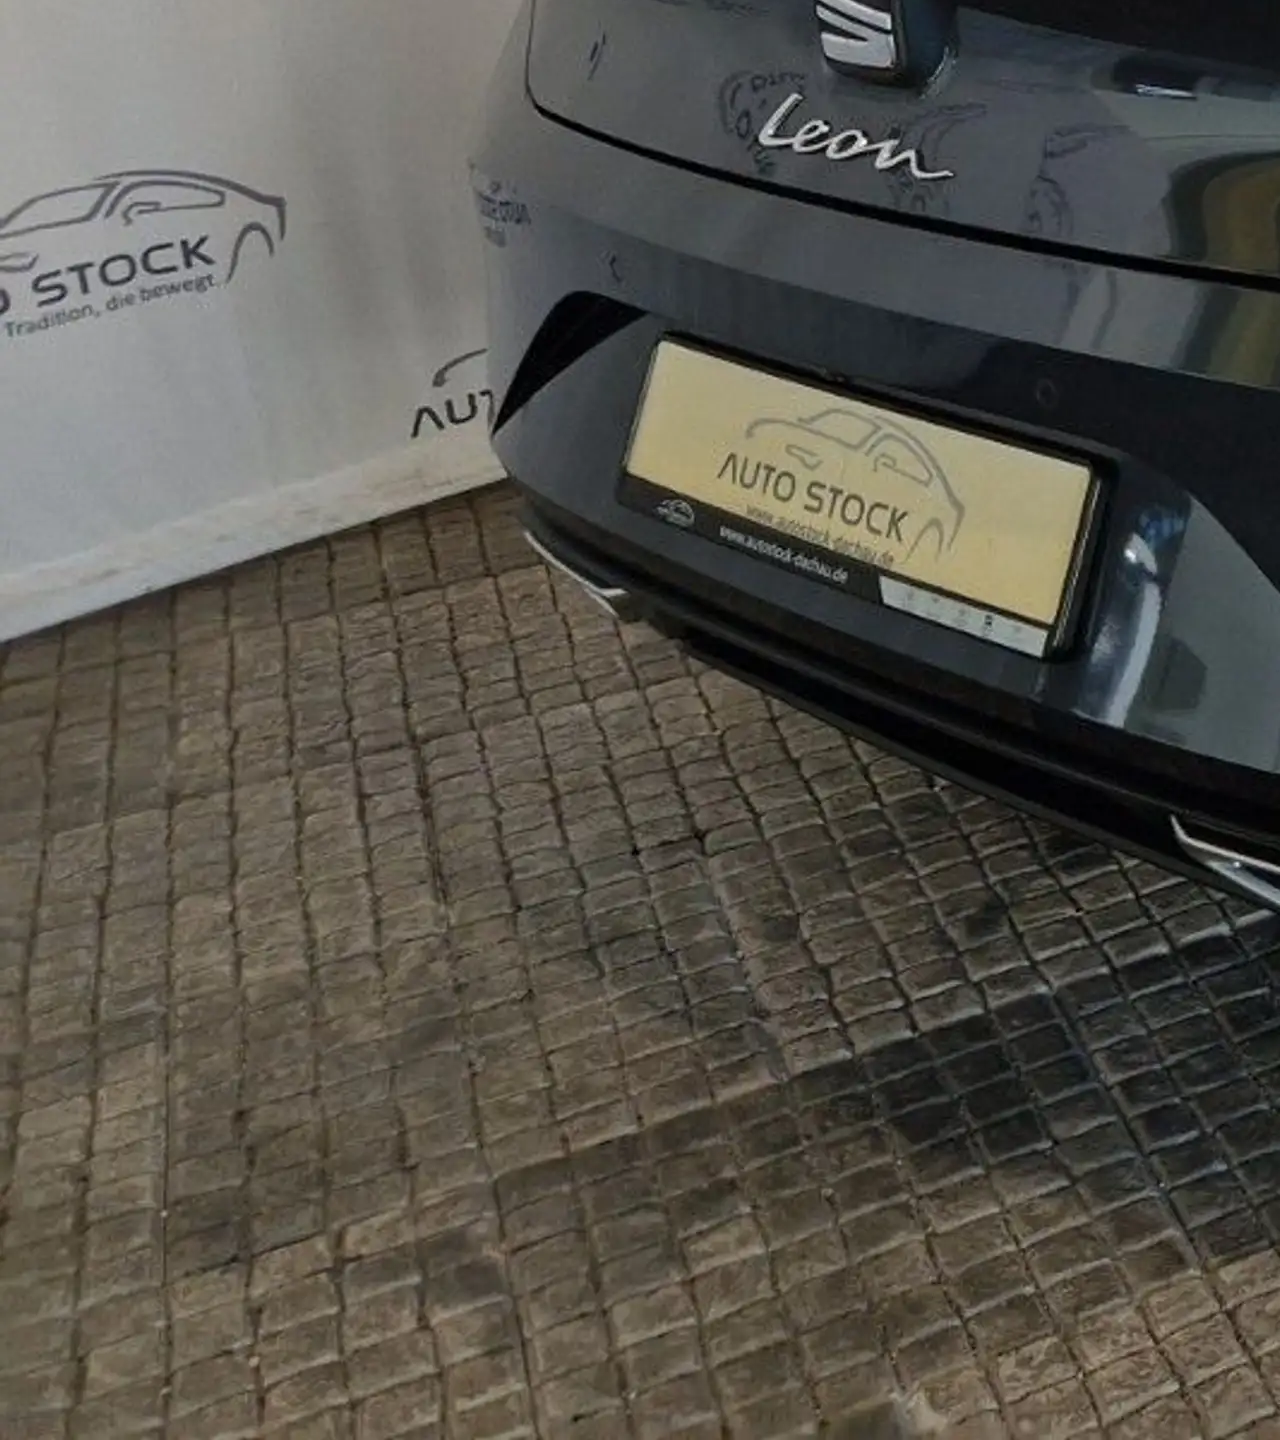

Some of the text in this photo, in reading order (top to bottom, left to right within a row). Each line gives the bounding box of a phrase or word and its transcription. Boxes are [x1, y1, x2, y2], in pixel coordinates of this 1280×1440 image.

[758, 92, 955, 180] Leon
[31, 234, 217, 309] STOCK
[4, 303, 100, 339] Tradition,
[105, 291, 137, 314] die
[716, 452, 909, 543] AUTO STOCK
